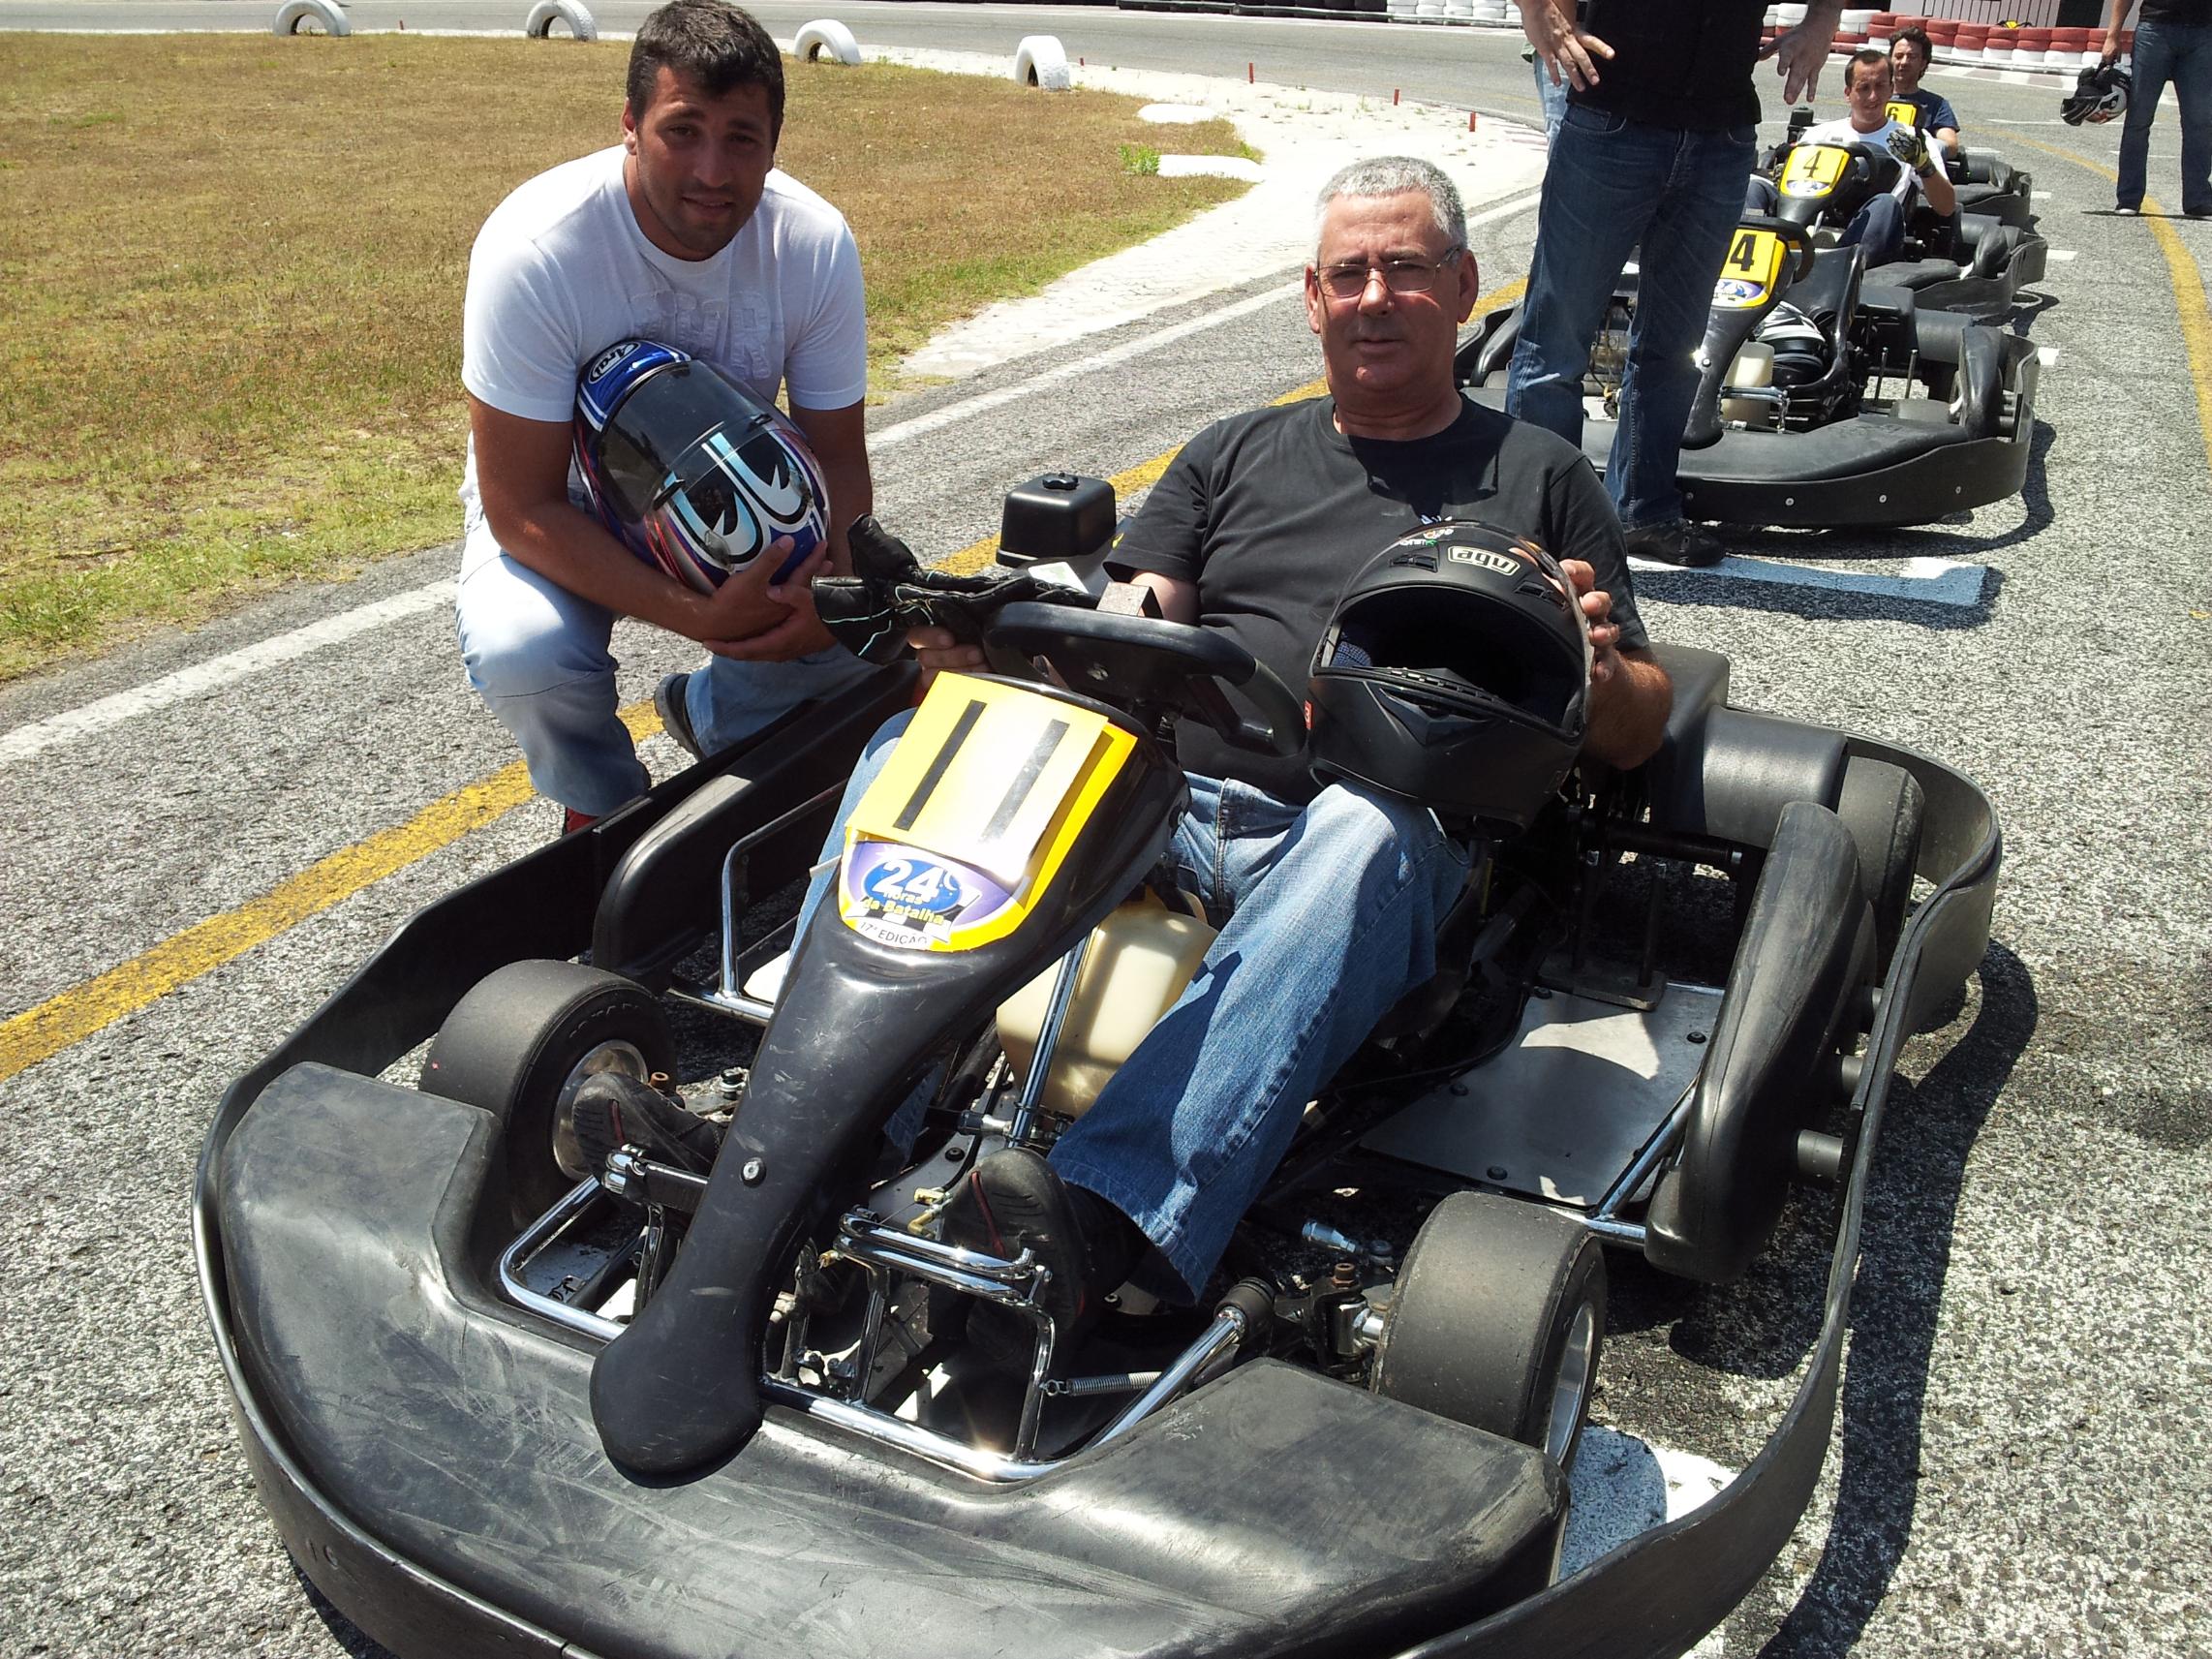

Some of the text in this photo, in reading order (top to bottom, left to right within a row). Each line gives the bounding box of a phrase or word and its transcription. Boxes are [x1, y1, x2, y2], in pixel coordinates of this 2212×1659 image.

[1888, 107, 1899, 121] 6
[1803, 150, 1822, 178] 4
[1729, 233, 1758, 272] 4
[1457, 549, 1510, 568] agv
[893, 699, 1070, 845] 11
[872, 859, 944, 903] 24
[861, 897, 945, 926] da Batalha
